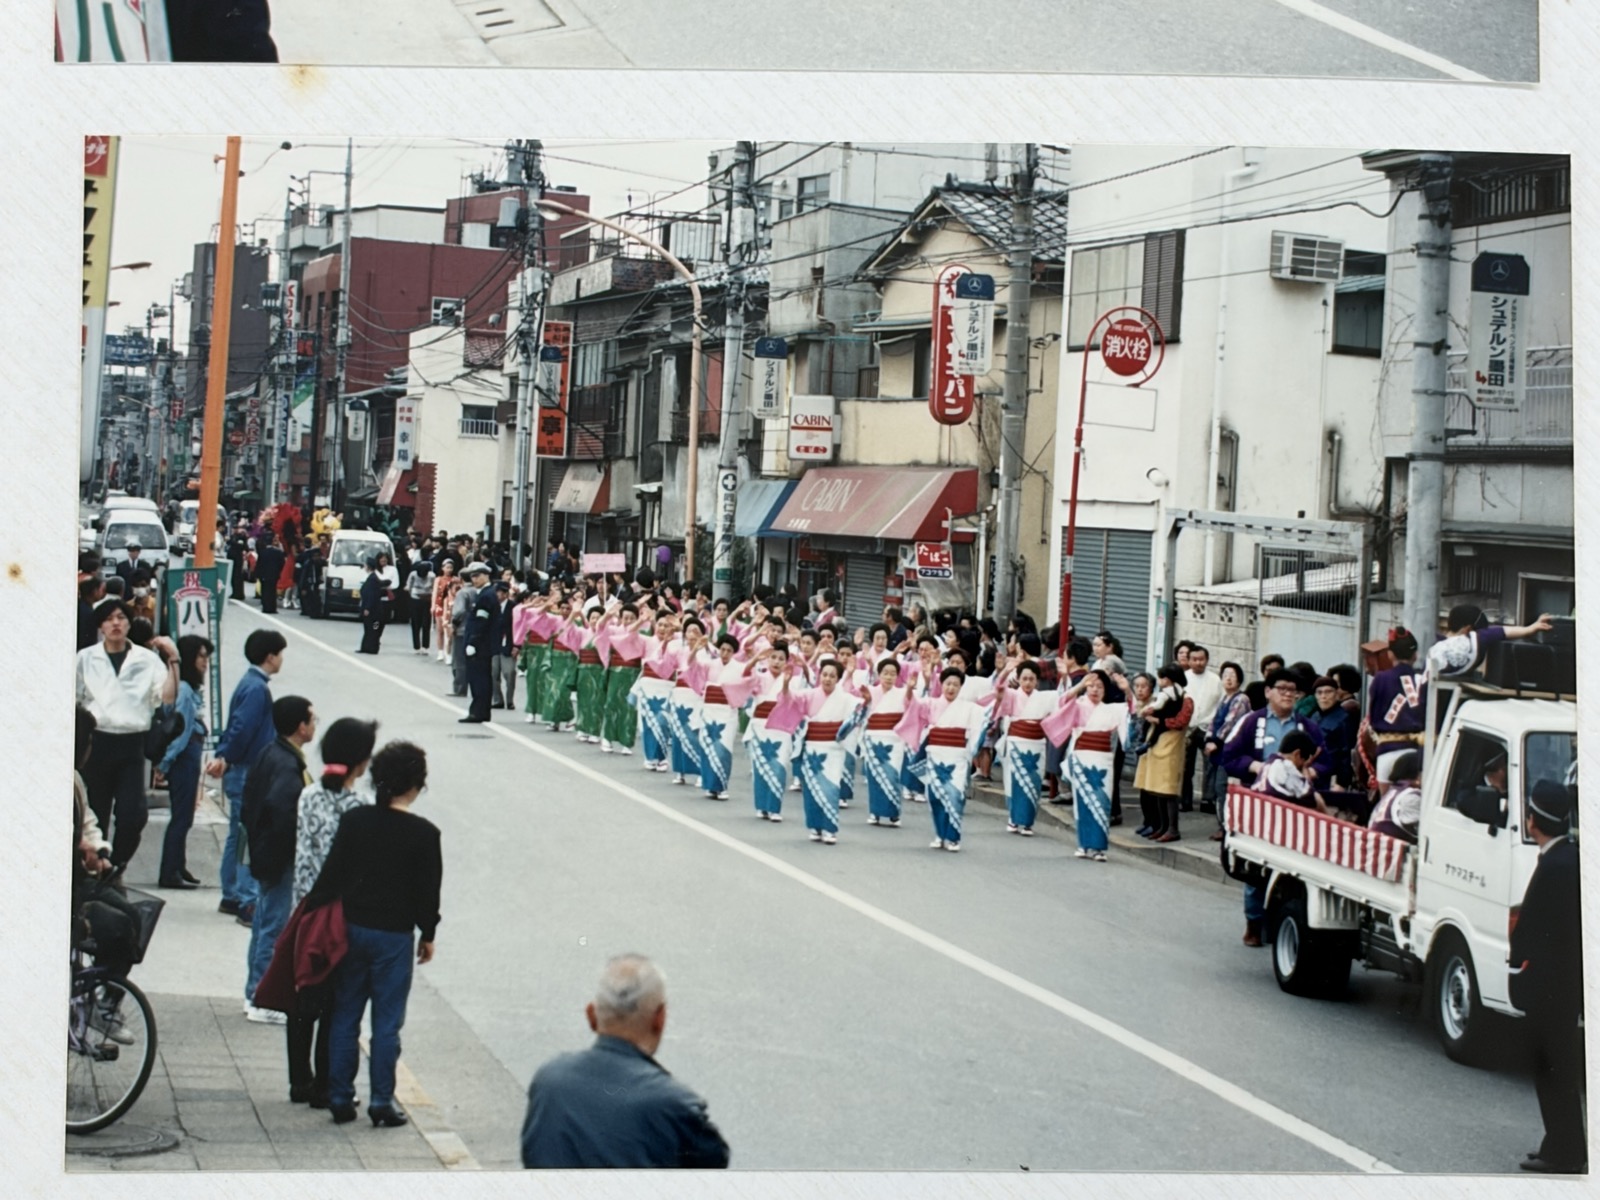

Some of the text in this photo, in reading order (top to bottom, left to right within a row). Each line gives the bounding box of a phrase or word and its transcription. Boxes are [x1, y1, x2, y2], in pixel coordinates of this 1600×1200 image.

[966, 301, 981, 361] シュテルン墨田
[1488, 296, 1508, 387] シュテルン墨田
[1105, 334, 1149, 361] 消火栓
[793, 414, 832, 427] CABIN
[802, 477, 862, 512] CABIN
[918, 544, 950, 567] たばこ
[184, 571, 201, 588] 祝
